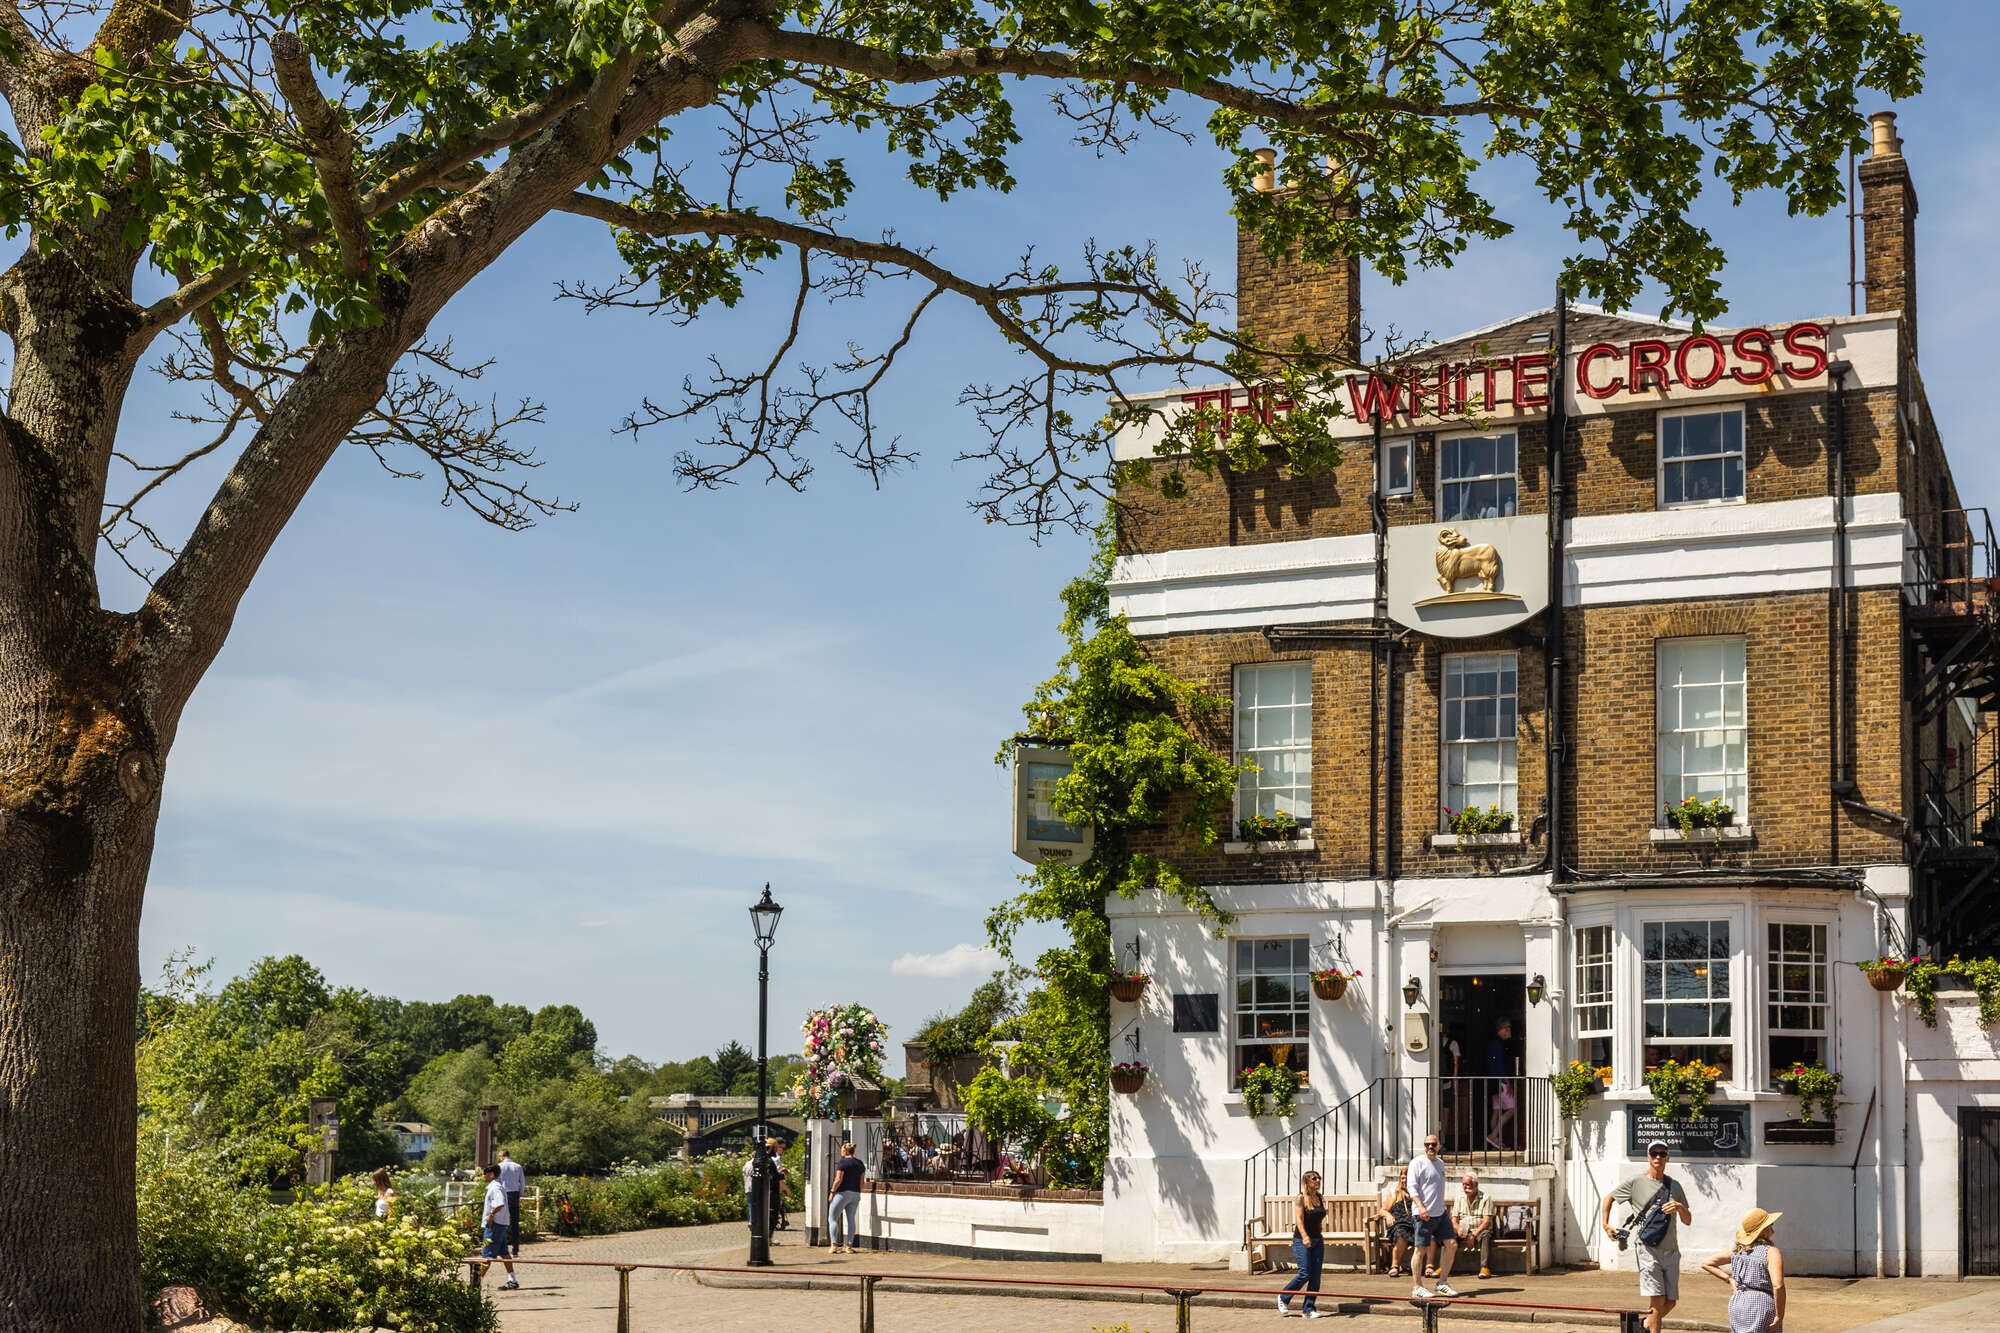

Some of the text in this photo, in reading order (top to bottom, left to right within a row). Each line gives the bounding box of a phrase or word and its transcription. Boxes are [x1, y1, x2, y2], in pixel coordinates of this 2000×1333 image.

[1345, 354, 1550, 424] WHITE
[1576, 322, 1829, 399] CROSS
[1038, 847, 1073, 857] YOUNG'S
